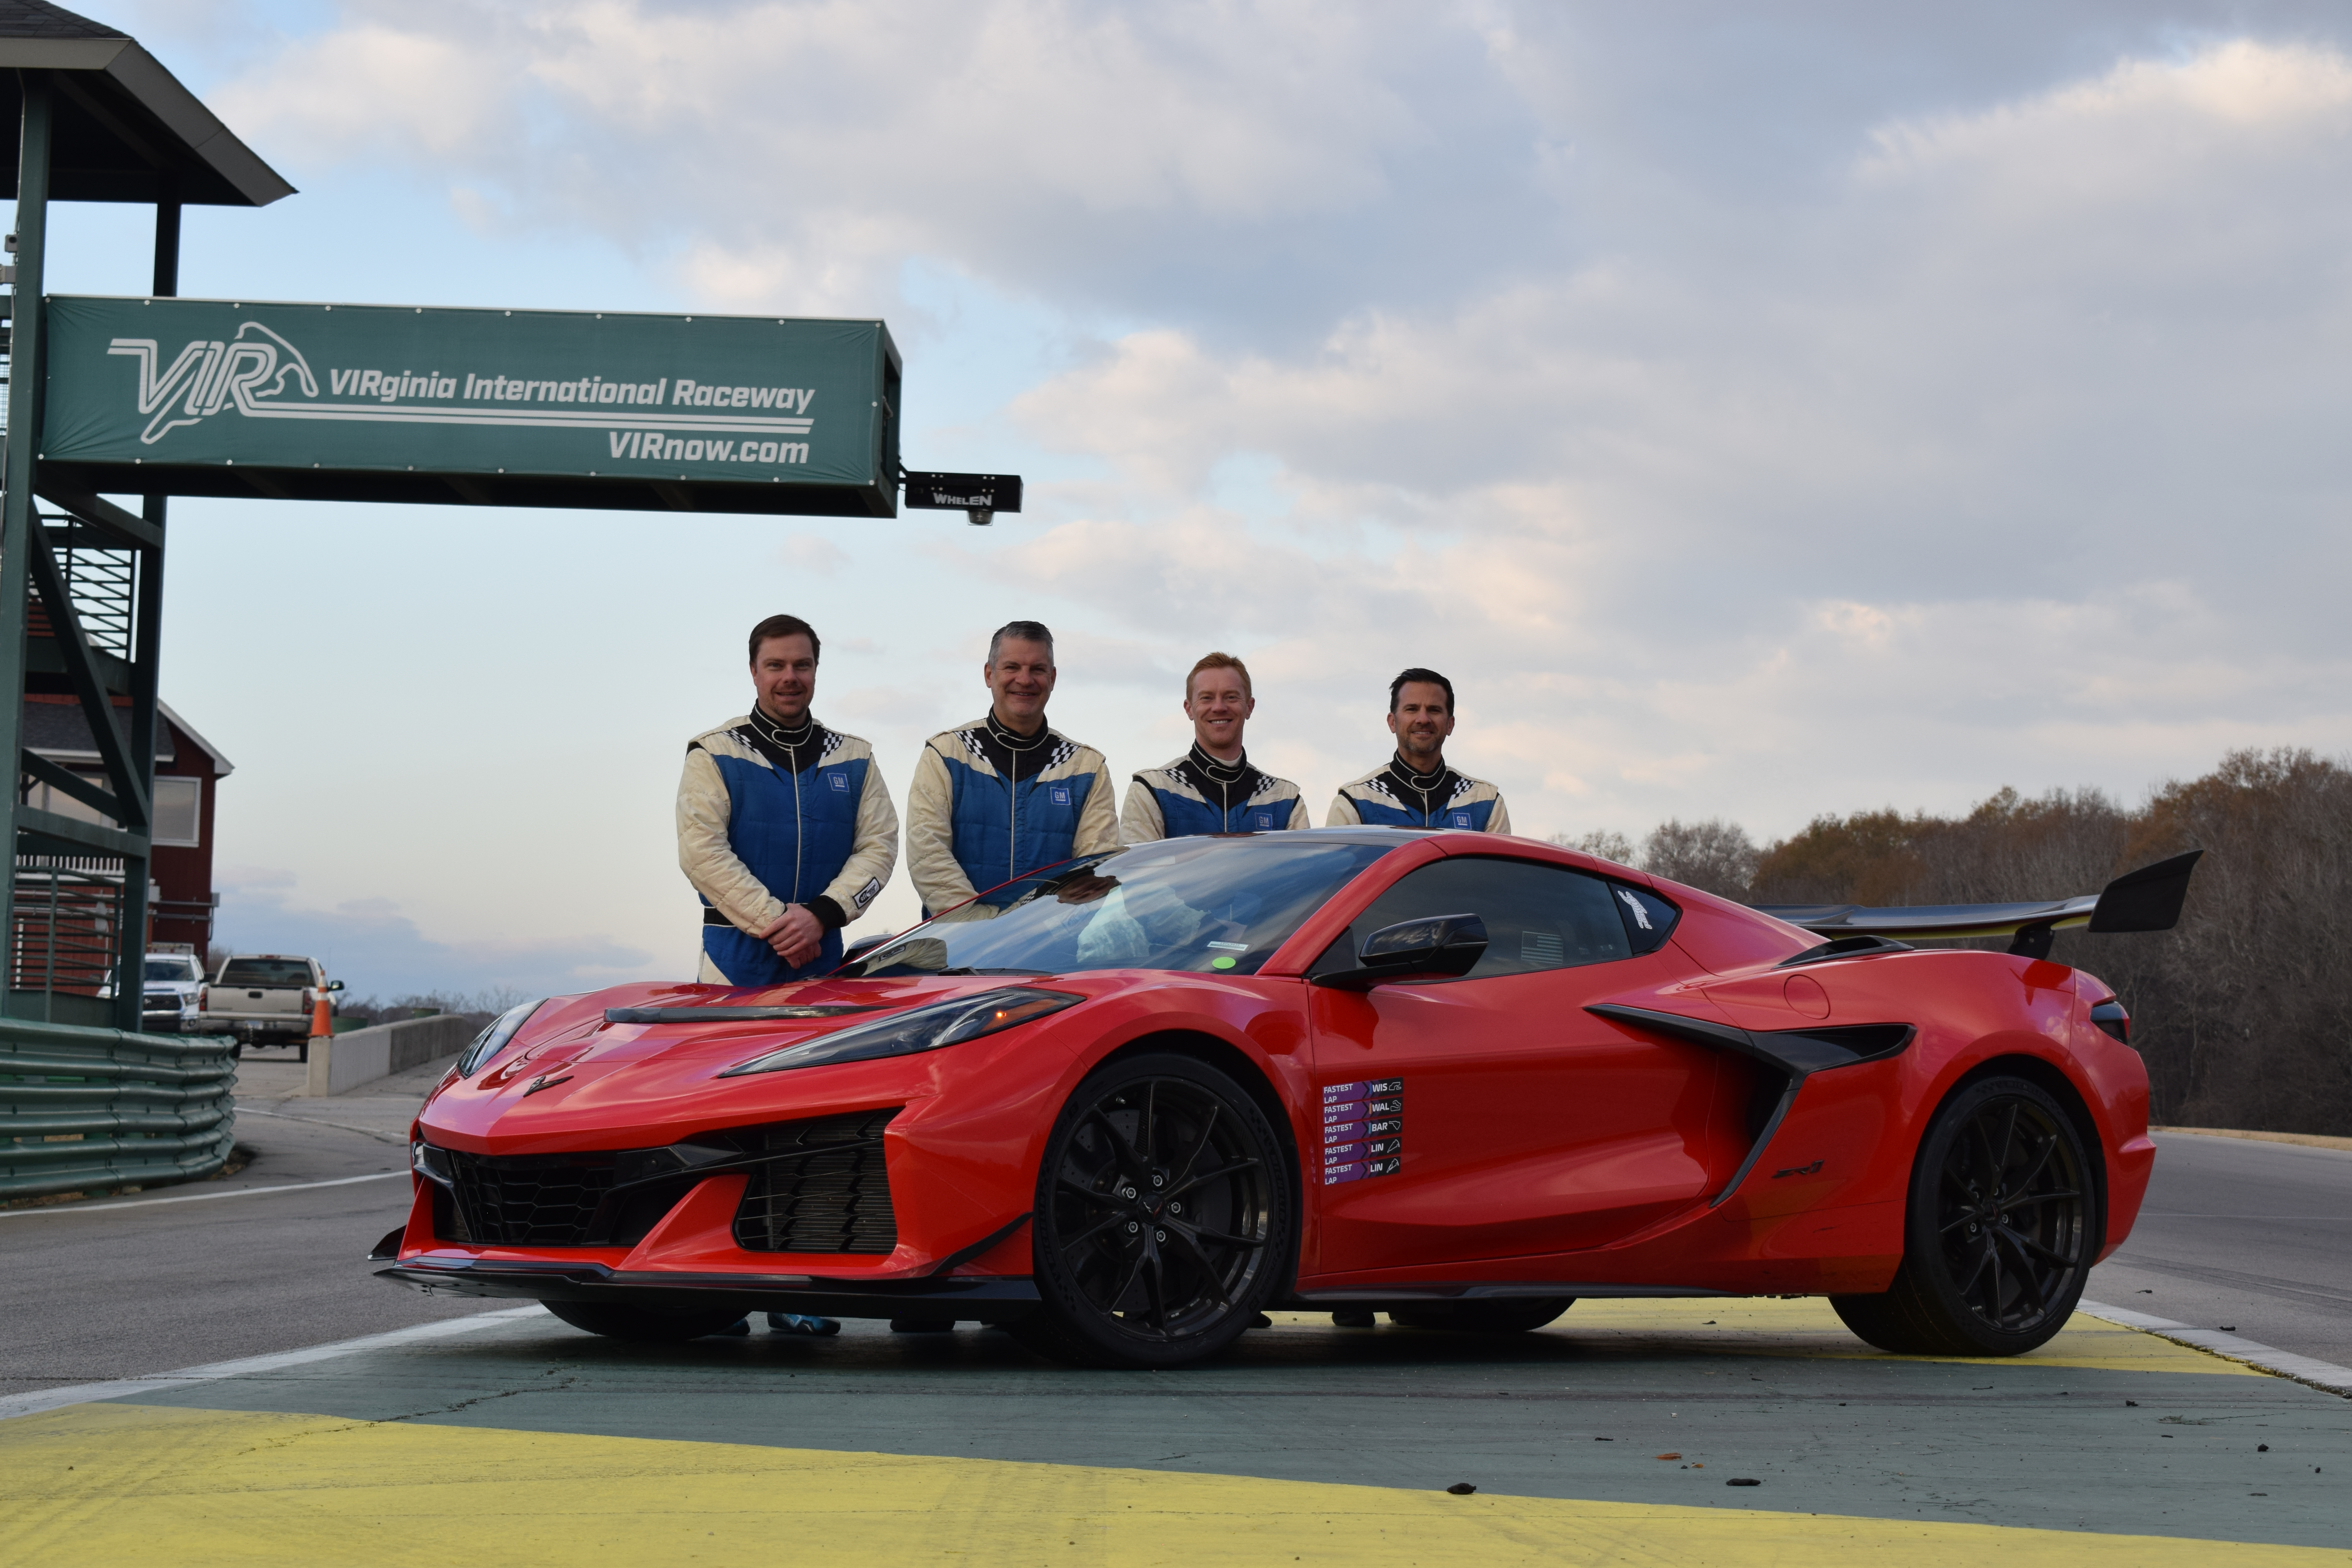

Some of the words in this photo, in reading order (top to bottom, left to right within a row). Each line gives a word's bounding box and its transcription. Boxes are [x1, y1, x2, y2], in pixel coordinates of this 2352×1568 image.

[107, 338, 277, 417] VIR
[330, 369, 457, 402] VIRginia
[463, 374, 667, 405] International
[672, 379, 815, 414] Raceway
[610, 432, 809, 464] VIRnow.com
[833, 777, 844, 785] GM
[1259, 816, 1269, 824] GM
[1324, 1083, 1353, 1093] FASTEST
[1372, 1083, 1387, 1092] WIS
[1324, 1103, 1353, 1113] FASTEST
[1372, 1103, 1389, 1112] WAL
[1325, 1123, 1353, 1133] FASTEST
[1372, 1122, 1388, 1132] BAR
[1325, 1144, 1352, 1154] FASTEST
[1371, 1143, 1384, 1152] LIN
[1325, 1164, 1352, 1174] FASTEST
[1370, 1163, 1383, 1172] LIN
[1270, 1154, 1285, 1220] MICHELIN
[1040, 1196, 1054, 1263] MICHELIN
